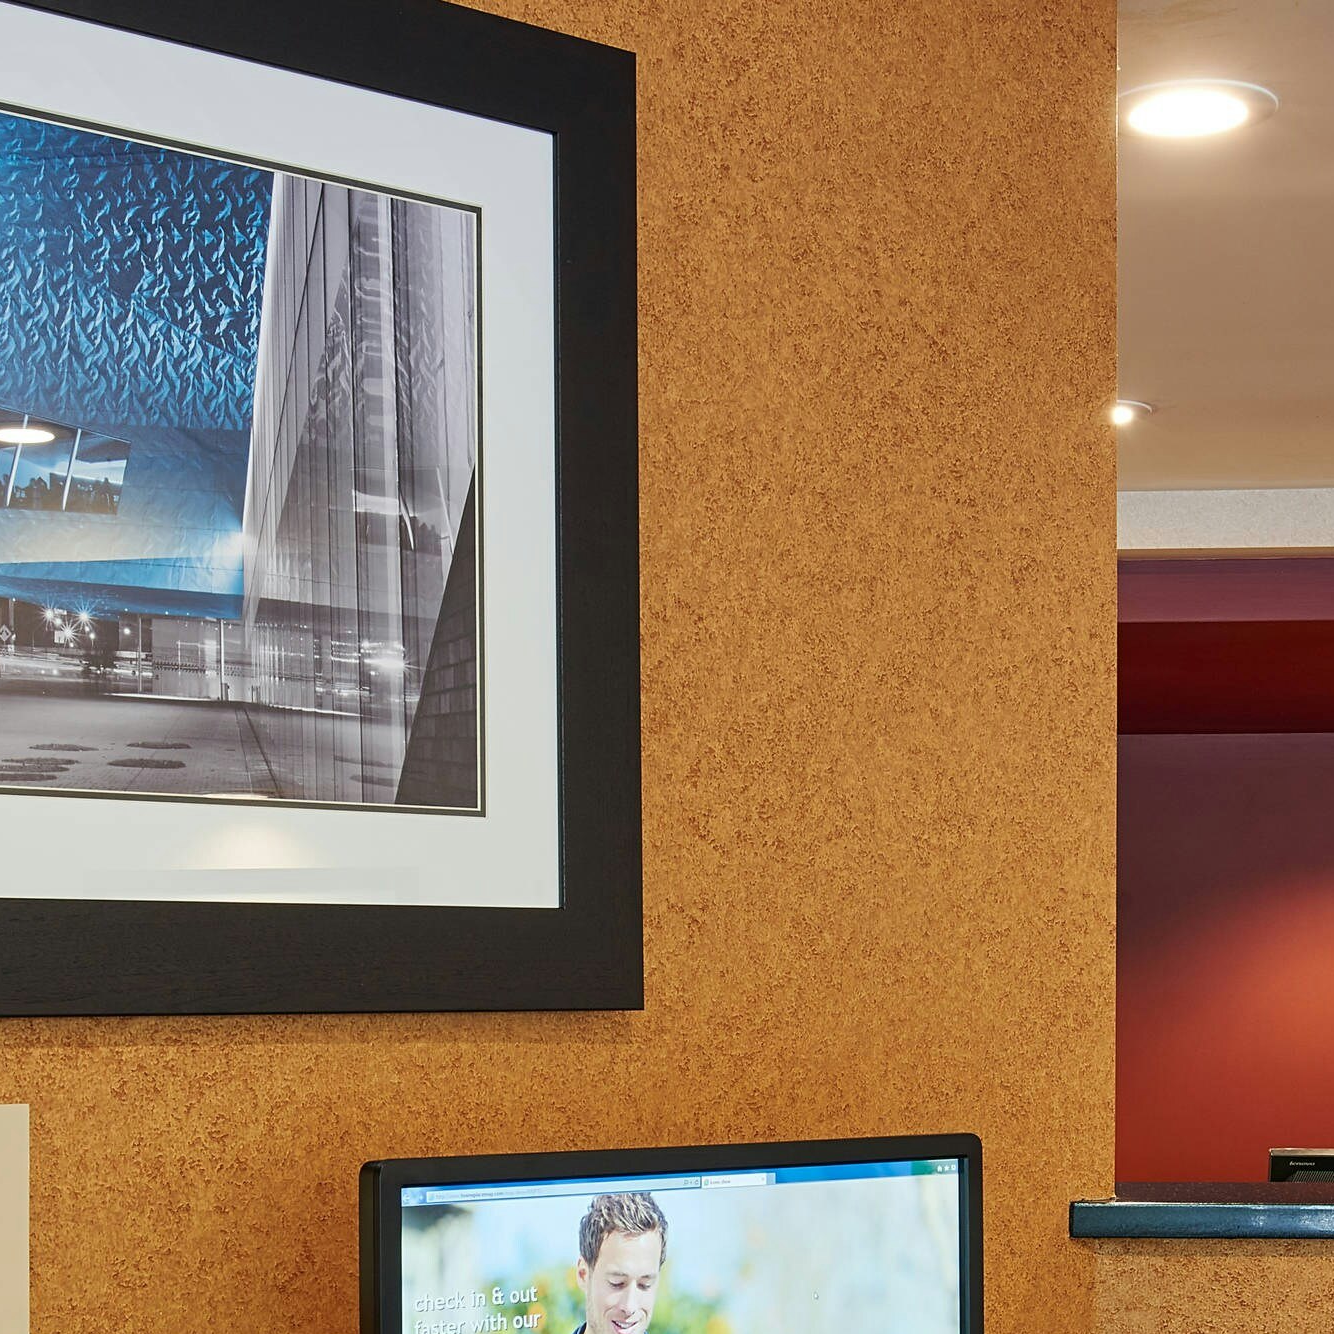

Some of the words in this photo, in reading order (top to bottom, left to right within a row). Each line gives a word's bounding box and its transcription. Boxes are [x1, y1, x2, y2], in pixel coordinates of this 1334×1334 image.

[415, 1291, 465, 1313] check
[472, 1292, 486, 1308] in
[492, 1287, 504, 1305] &
[509, 1286, 538, 1304] out
[472, 1314, 507, 1333] with
[512, 1313, 542, 1329] our
